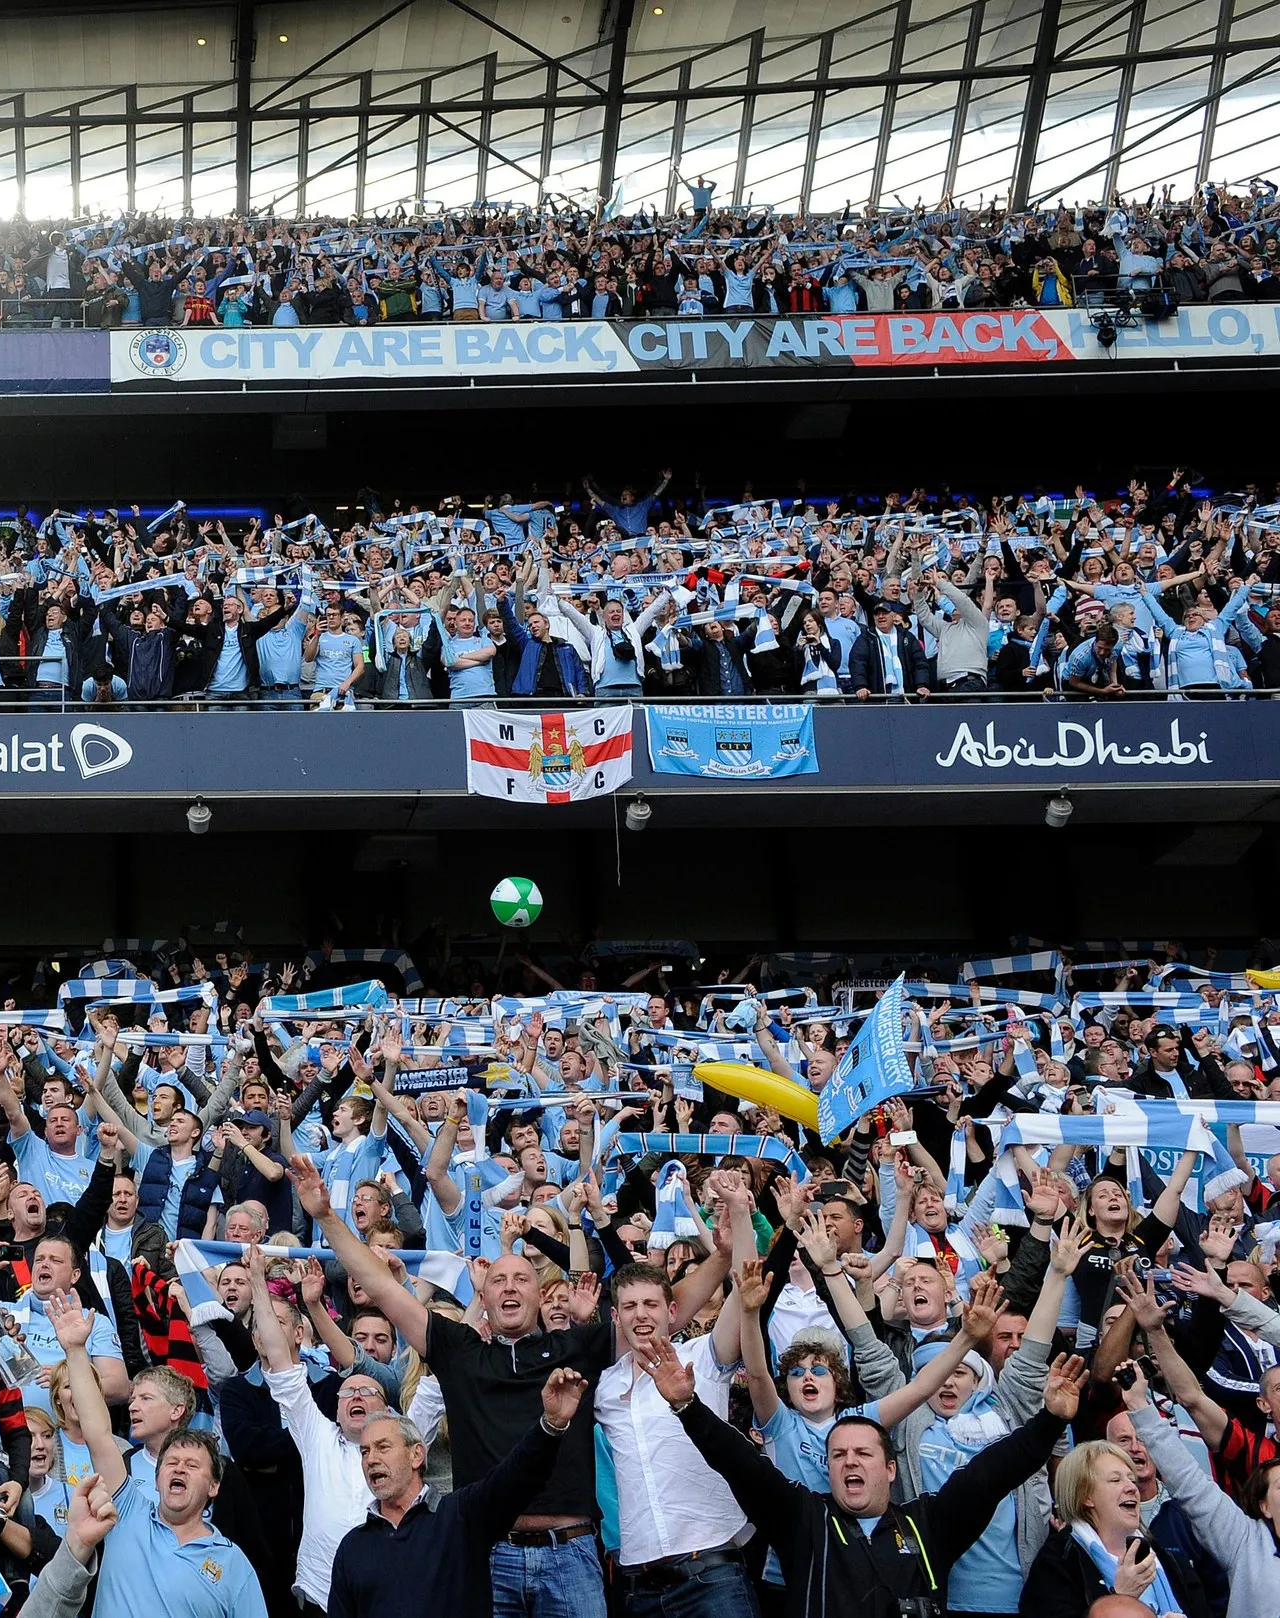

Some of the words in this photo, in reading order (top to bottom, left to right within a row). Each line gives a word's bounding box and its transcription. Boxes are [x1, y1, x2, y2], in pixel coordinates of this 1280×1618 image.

[199, 332, 323, 370] CITY
[332, 327, 444, 367] ARE
[468, 325, 618, 371] BACK,
[628, 321, 756, 362] CITY
[765, 317, 880, 358] ARE
[889, 313, 1059, 361] BACK,
[654, 704, 769, 720] MANCHESTER
[771, 704, 809, 719] CITY
[499, 723, 515, 741] M
[593, 718, 606, 736] C
[506, 777, 515, 795] F
[594, 771, 605, 789] C
[409, 1080, 447, 1090] FOOTBALL
